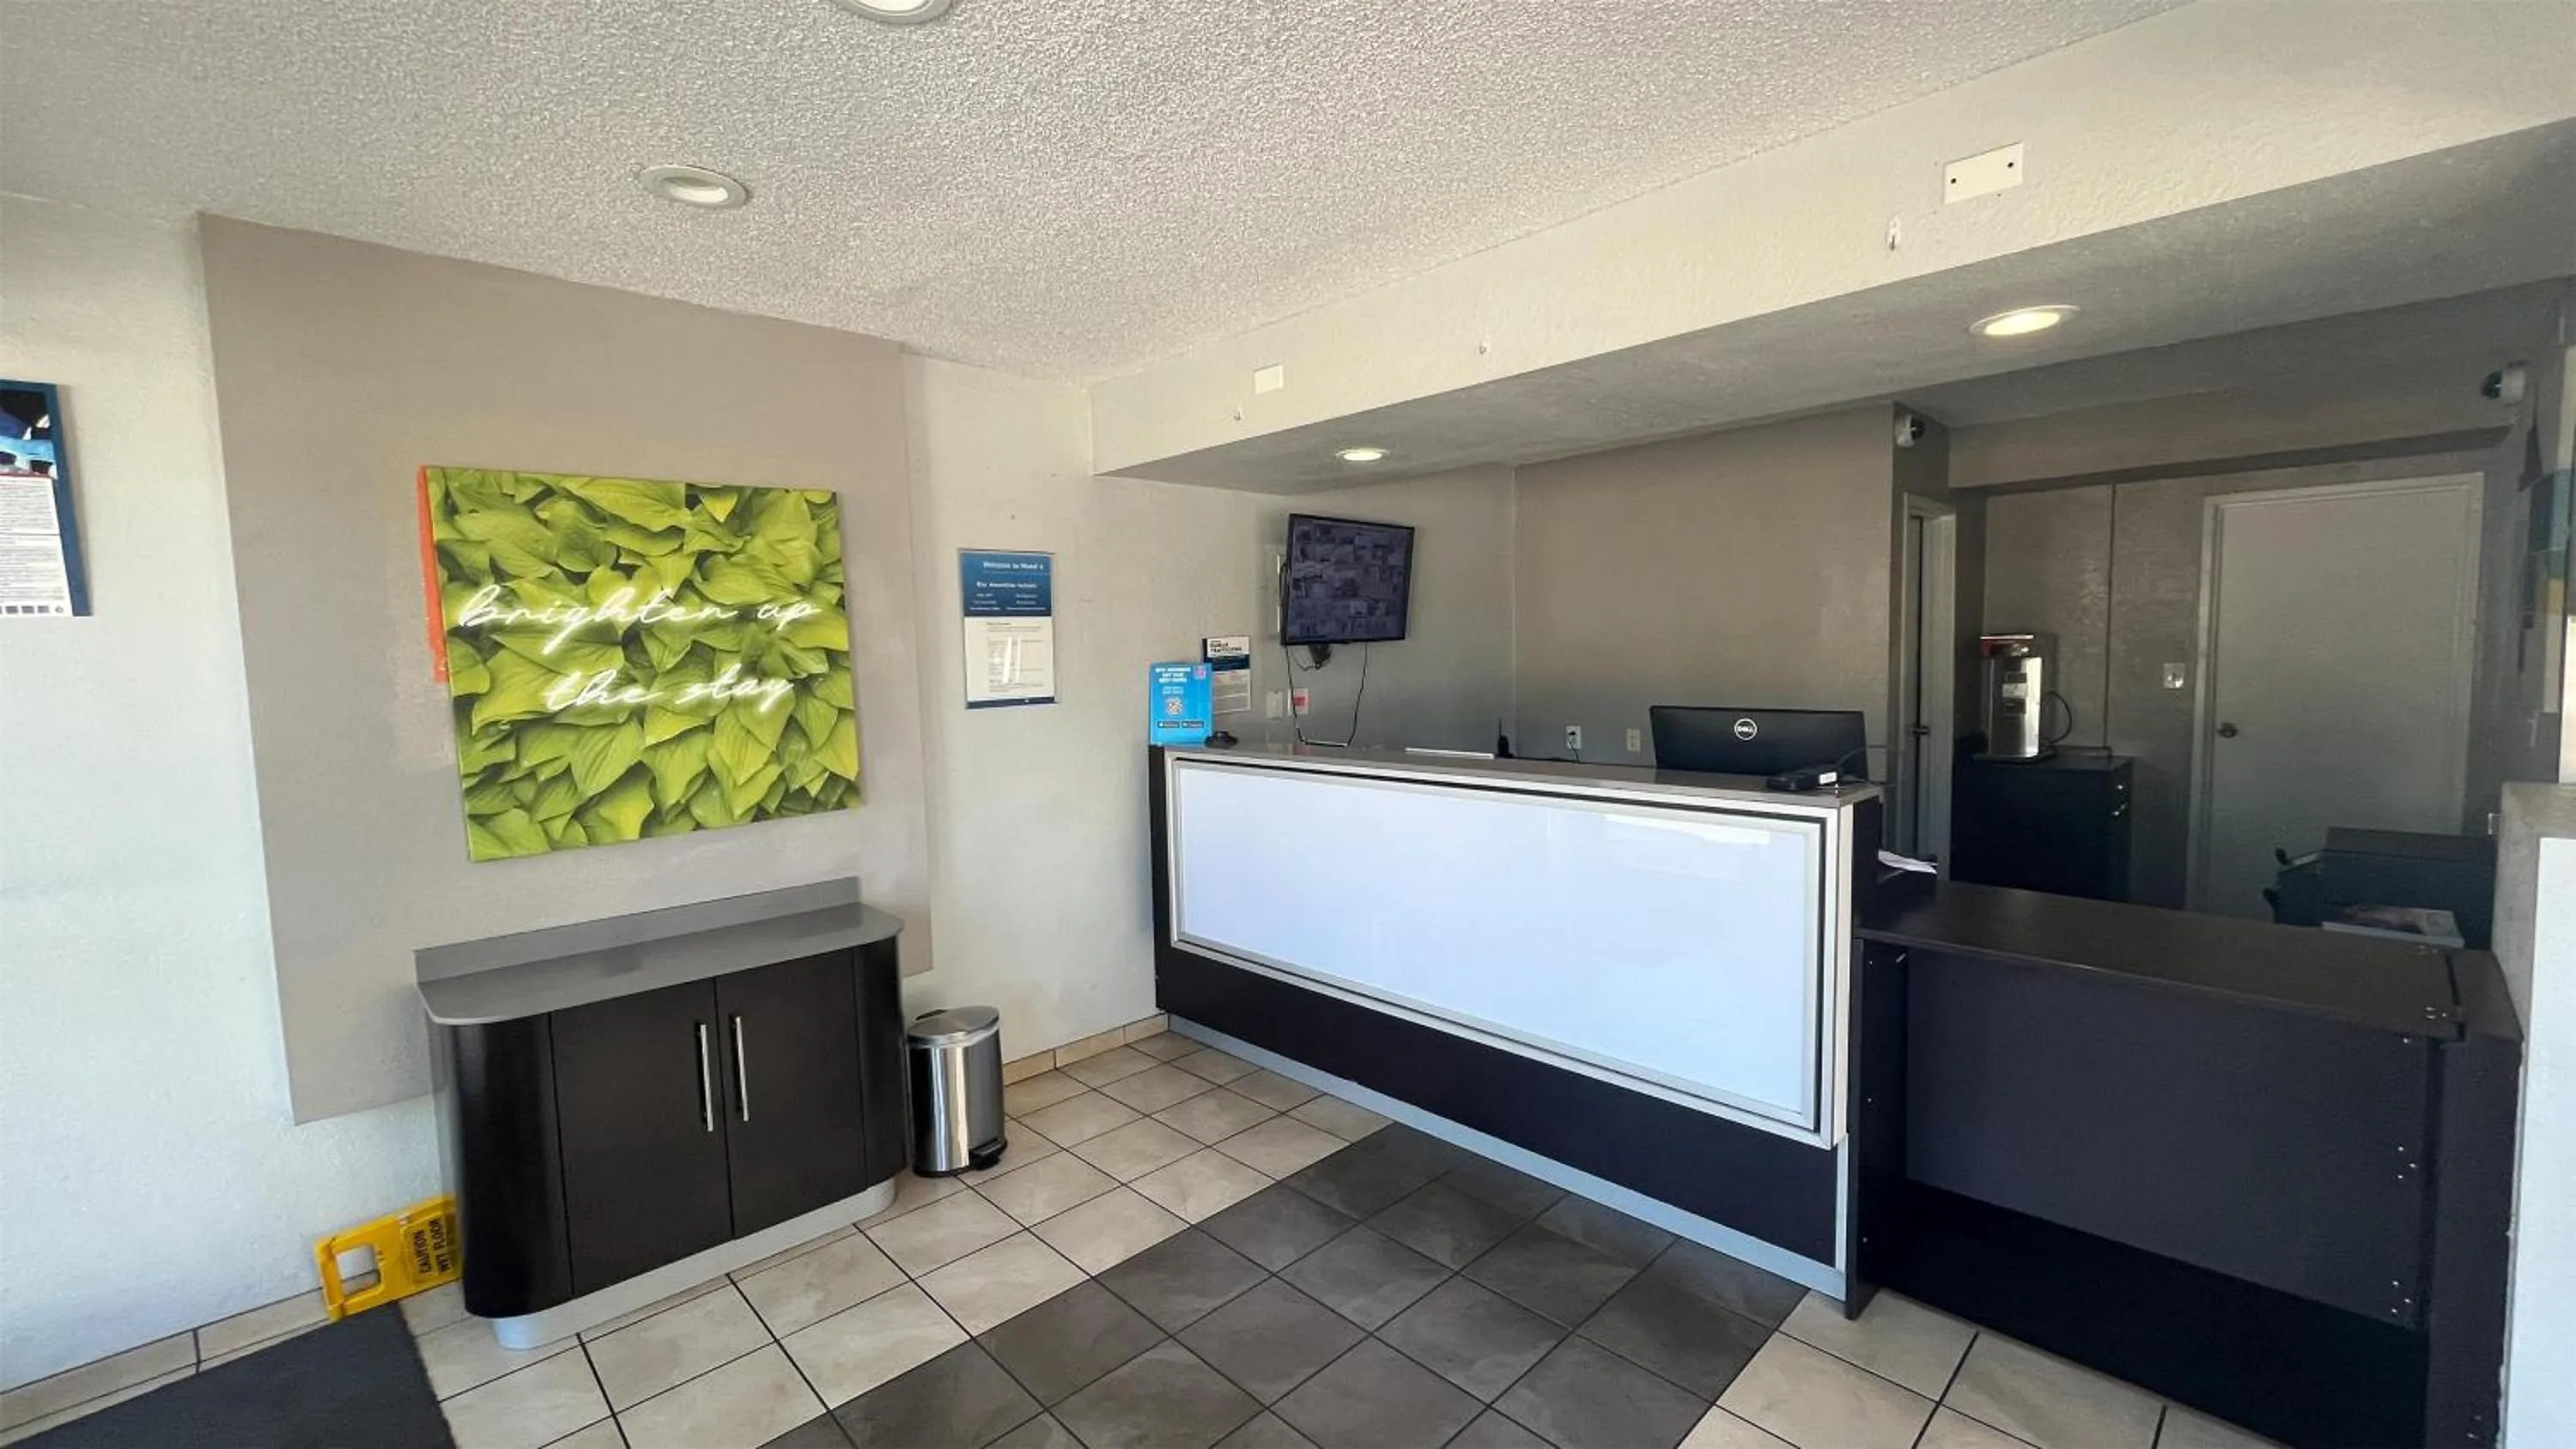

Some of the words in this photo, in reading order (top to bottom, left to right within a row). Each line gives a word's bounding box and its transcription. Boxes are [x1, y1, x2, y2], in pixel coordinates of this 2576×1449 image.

[458, 584, 739, 655] brighten
[756, 603, 822, 631] up
[541, 670, 665, 712] the
[674, 662, 795, 713] stay
